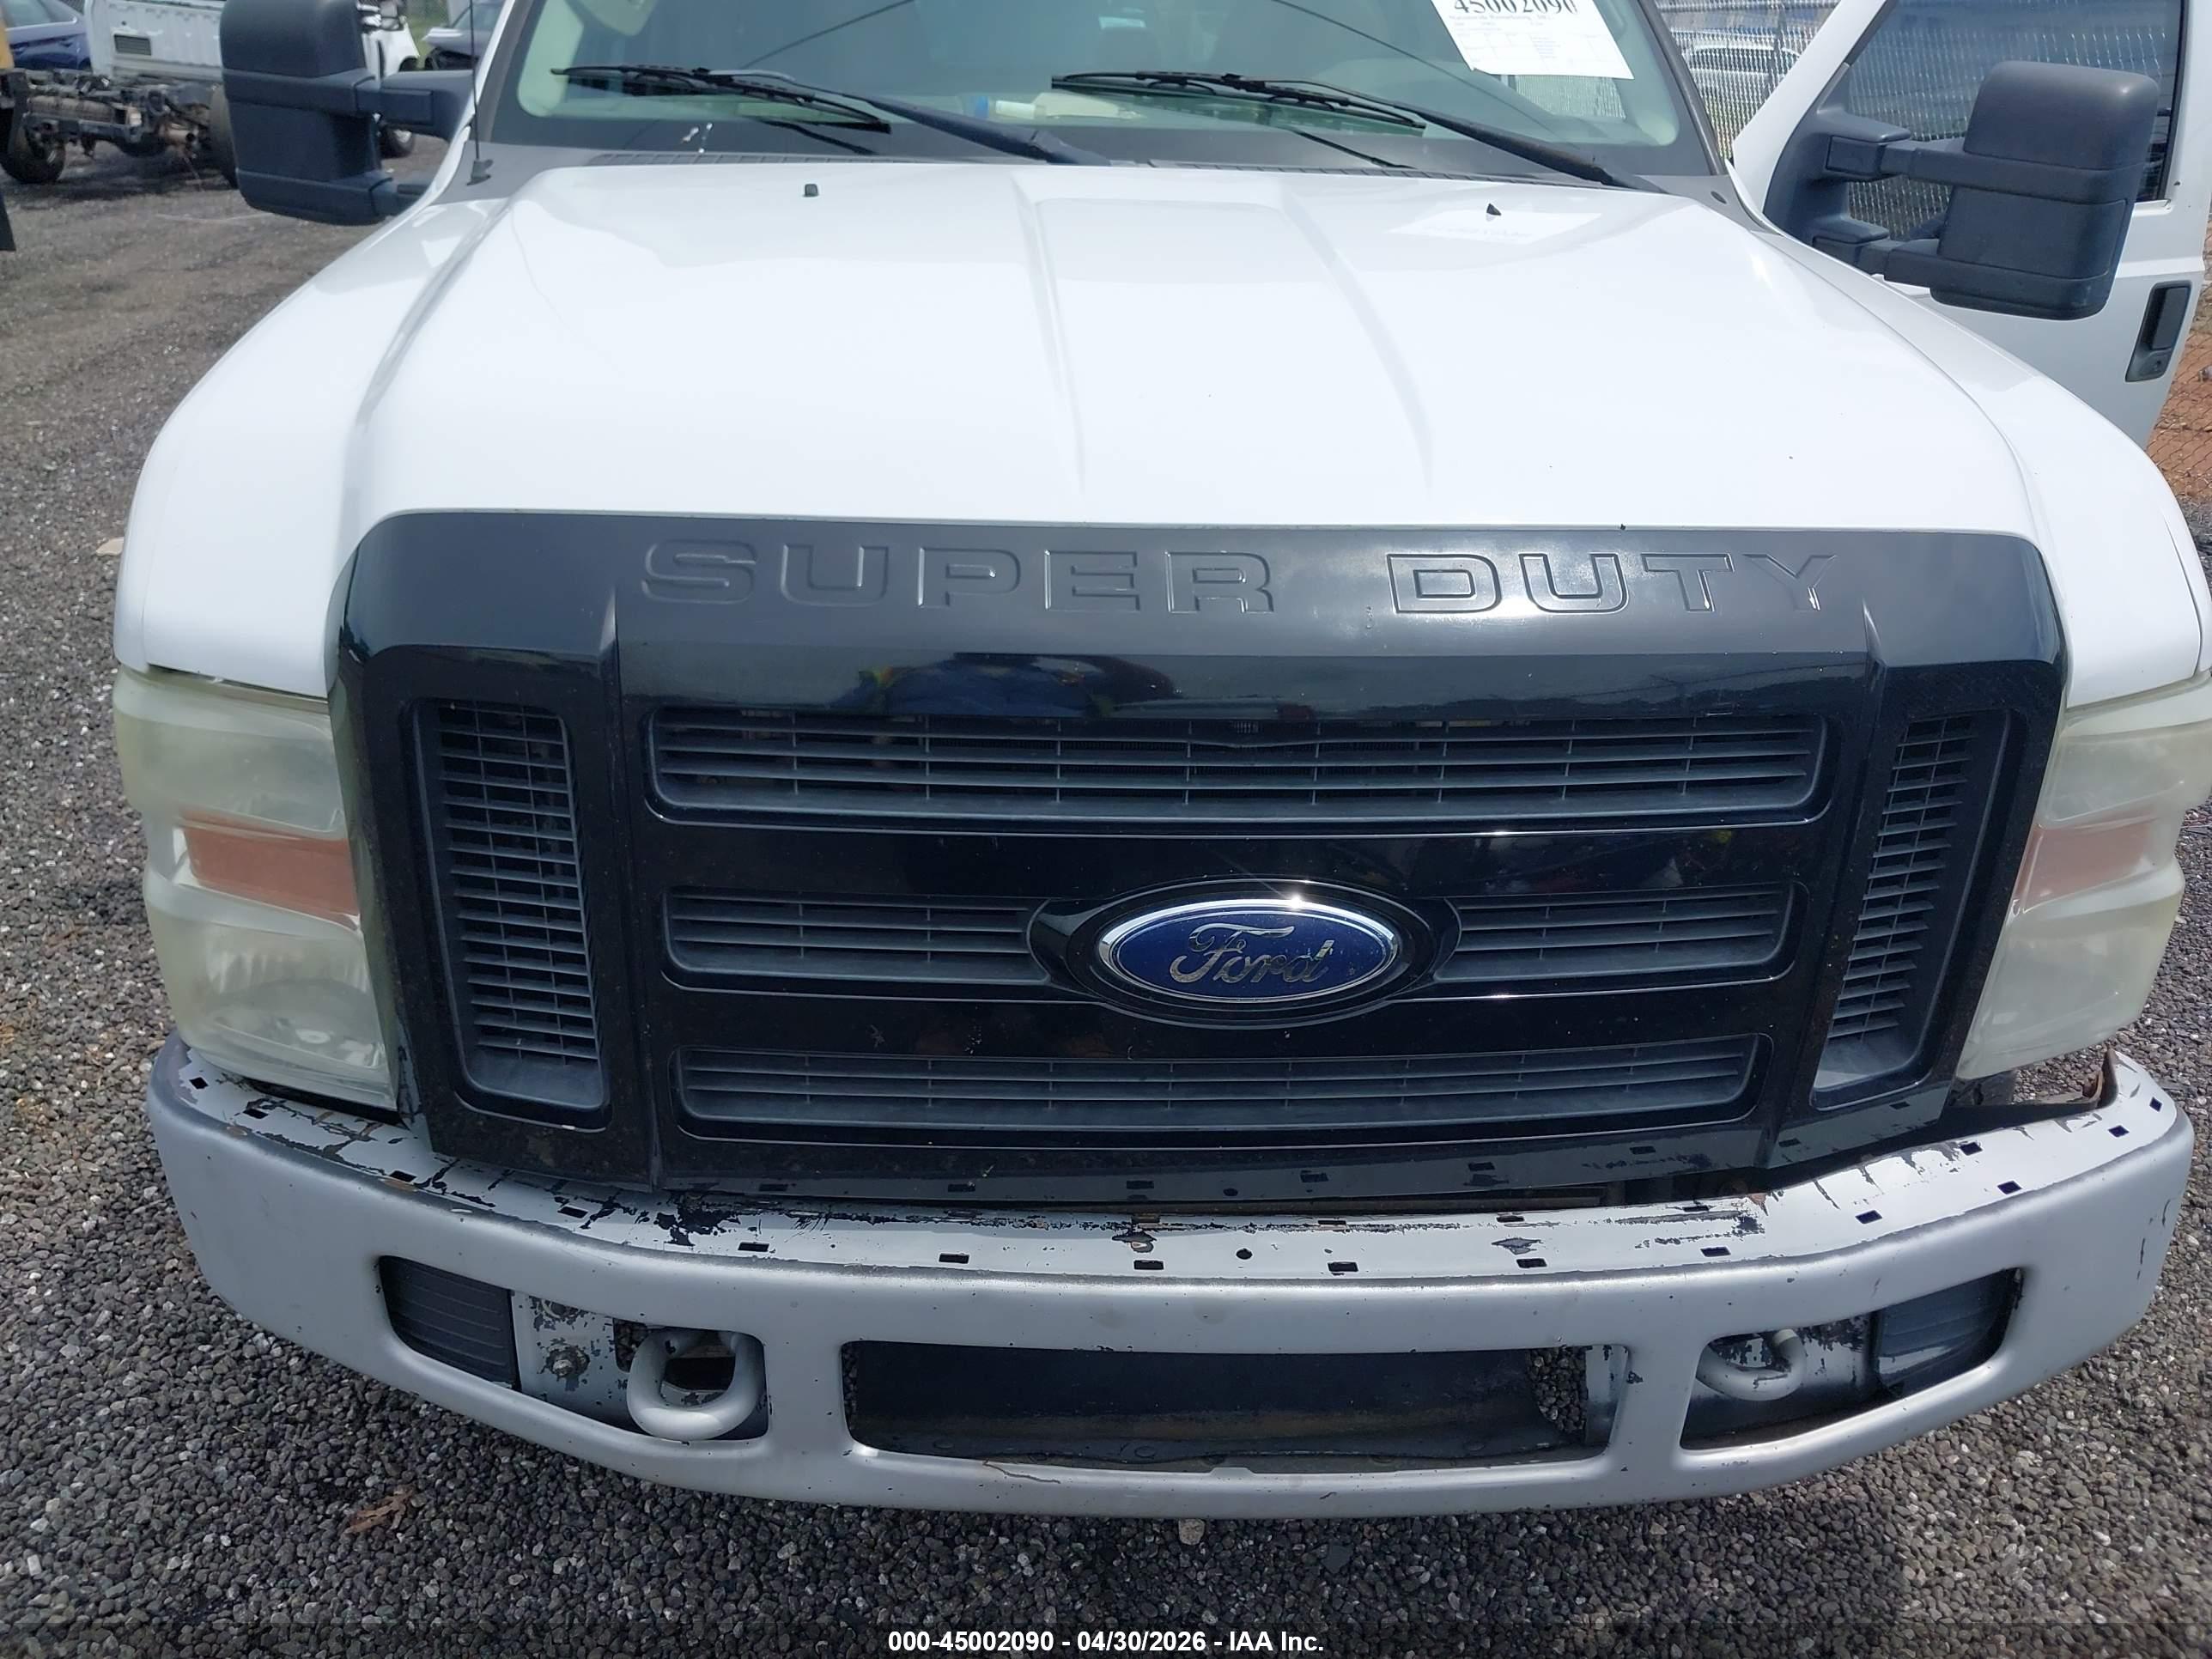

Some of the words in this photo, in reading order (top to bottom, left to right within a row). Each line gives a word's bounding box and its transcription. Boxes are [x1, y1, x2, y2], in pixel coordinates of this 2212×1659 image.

[641, 539, 1274, 614] SUPER
[1386, 553, 1837, 614] DUTY
[1169, 922, 1335, 984] Ford
